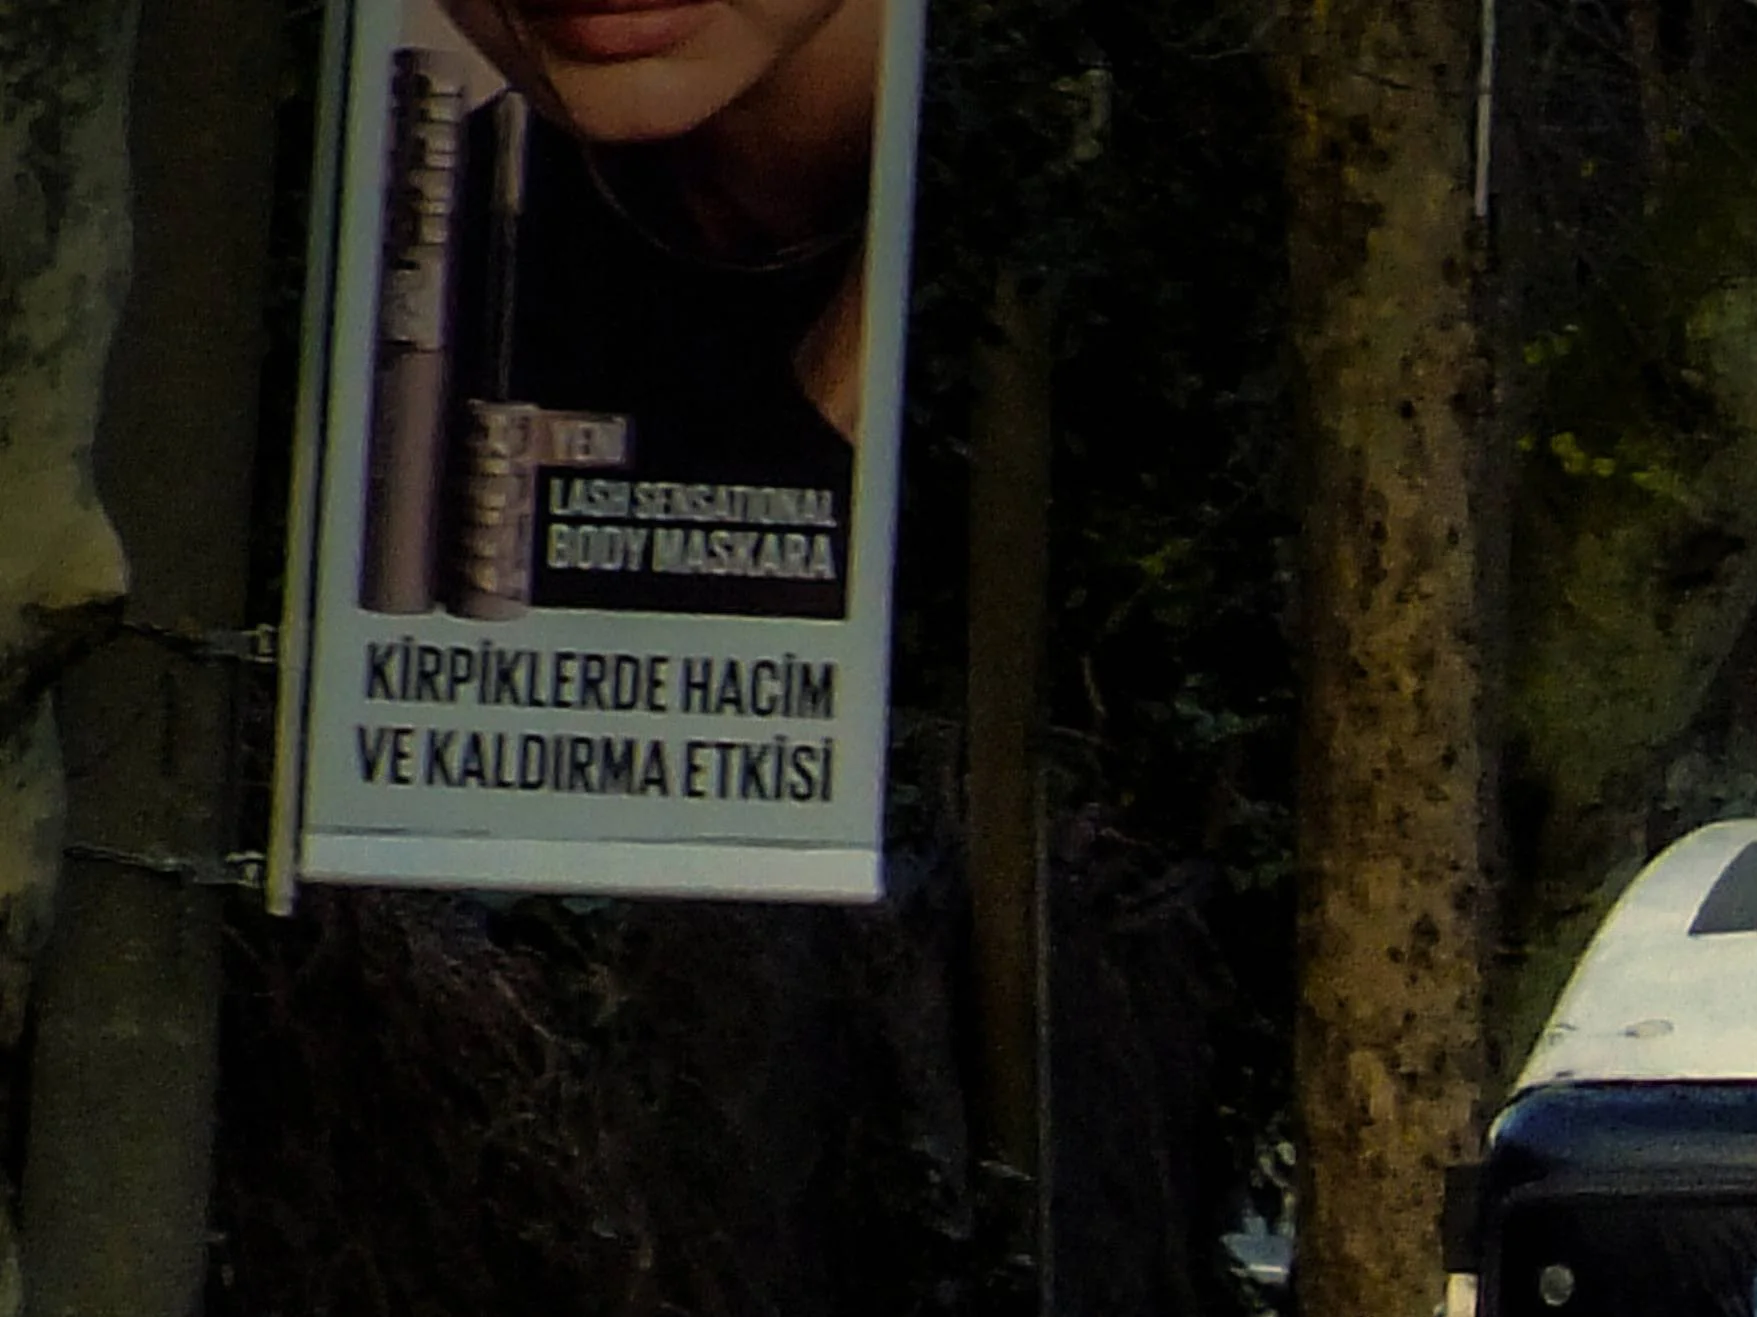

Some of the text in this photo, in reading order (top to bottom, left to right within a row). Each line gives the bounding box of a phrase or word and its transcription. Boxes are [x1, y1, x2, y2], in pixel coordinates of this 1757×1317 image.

[548, 523, 836, 580] BODY MASKARA
[364, 636, 838, 719] KİRPİKLERDE HACİM
[355, 725, 834, 802] VE KALDIRMA ETKİSİ
